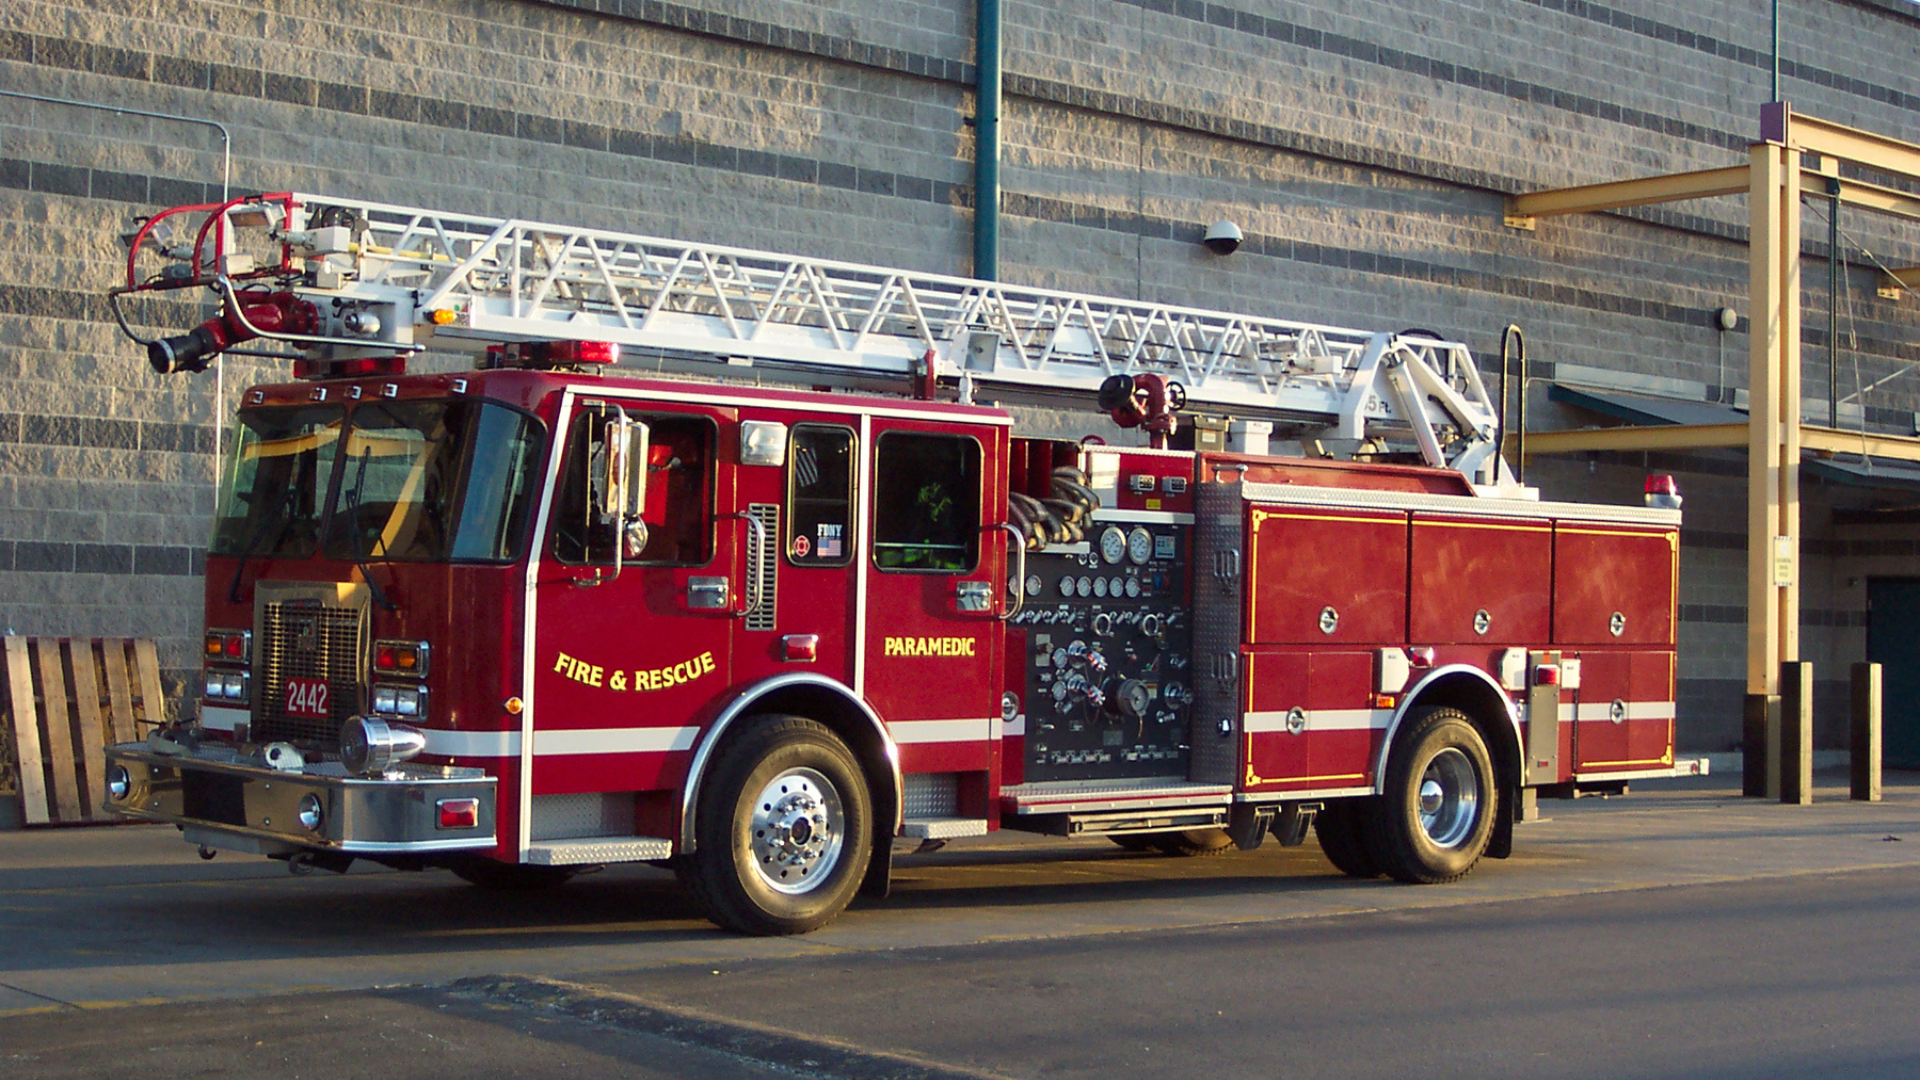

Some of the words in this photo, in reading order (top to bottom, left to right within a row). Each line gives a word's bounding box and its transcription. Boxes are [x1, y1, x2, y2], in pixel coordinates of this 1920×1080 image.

[1364, 395, 1377, 412] 5
[817, 523, 842, 537] FDNY
[884, 637, 976, 657] PARAMEDIC
[553, 651, 604, 689] FIRE
[609, 669, 627, 691] &
[634, 650, 717, 692] RESCUE
[287, 681, 328, 714] 2442
